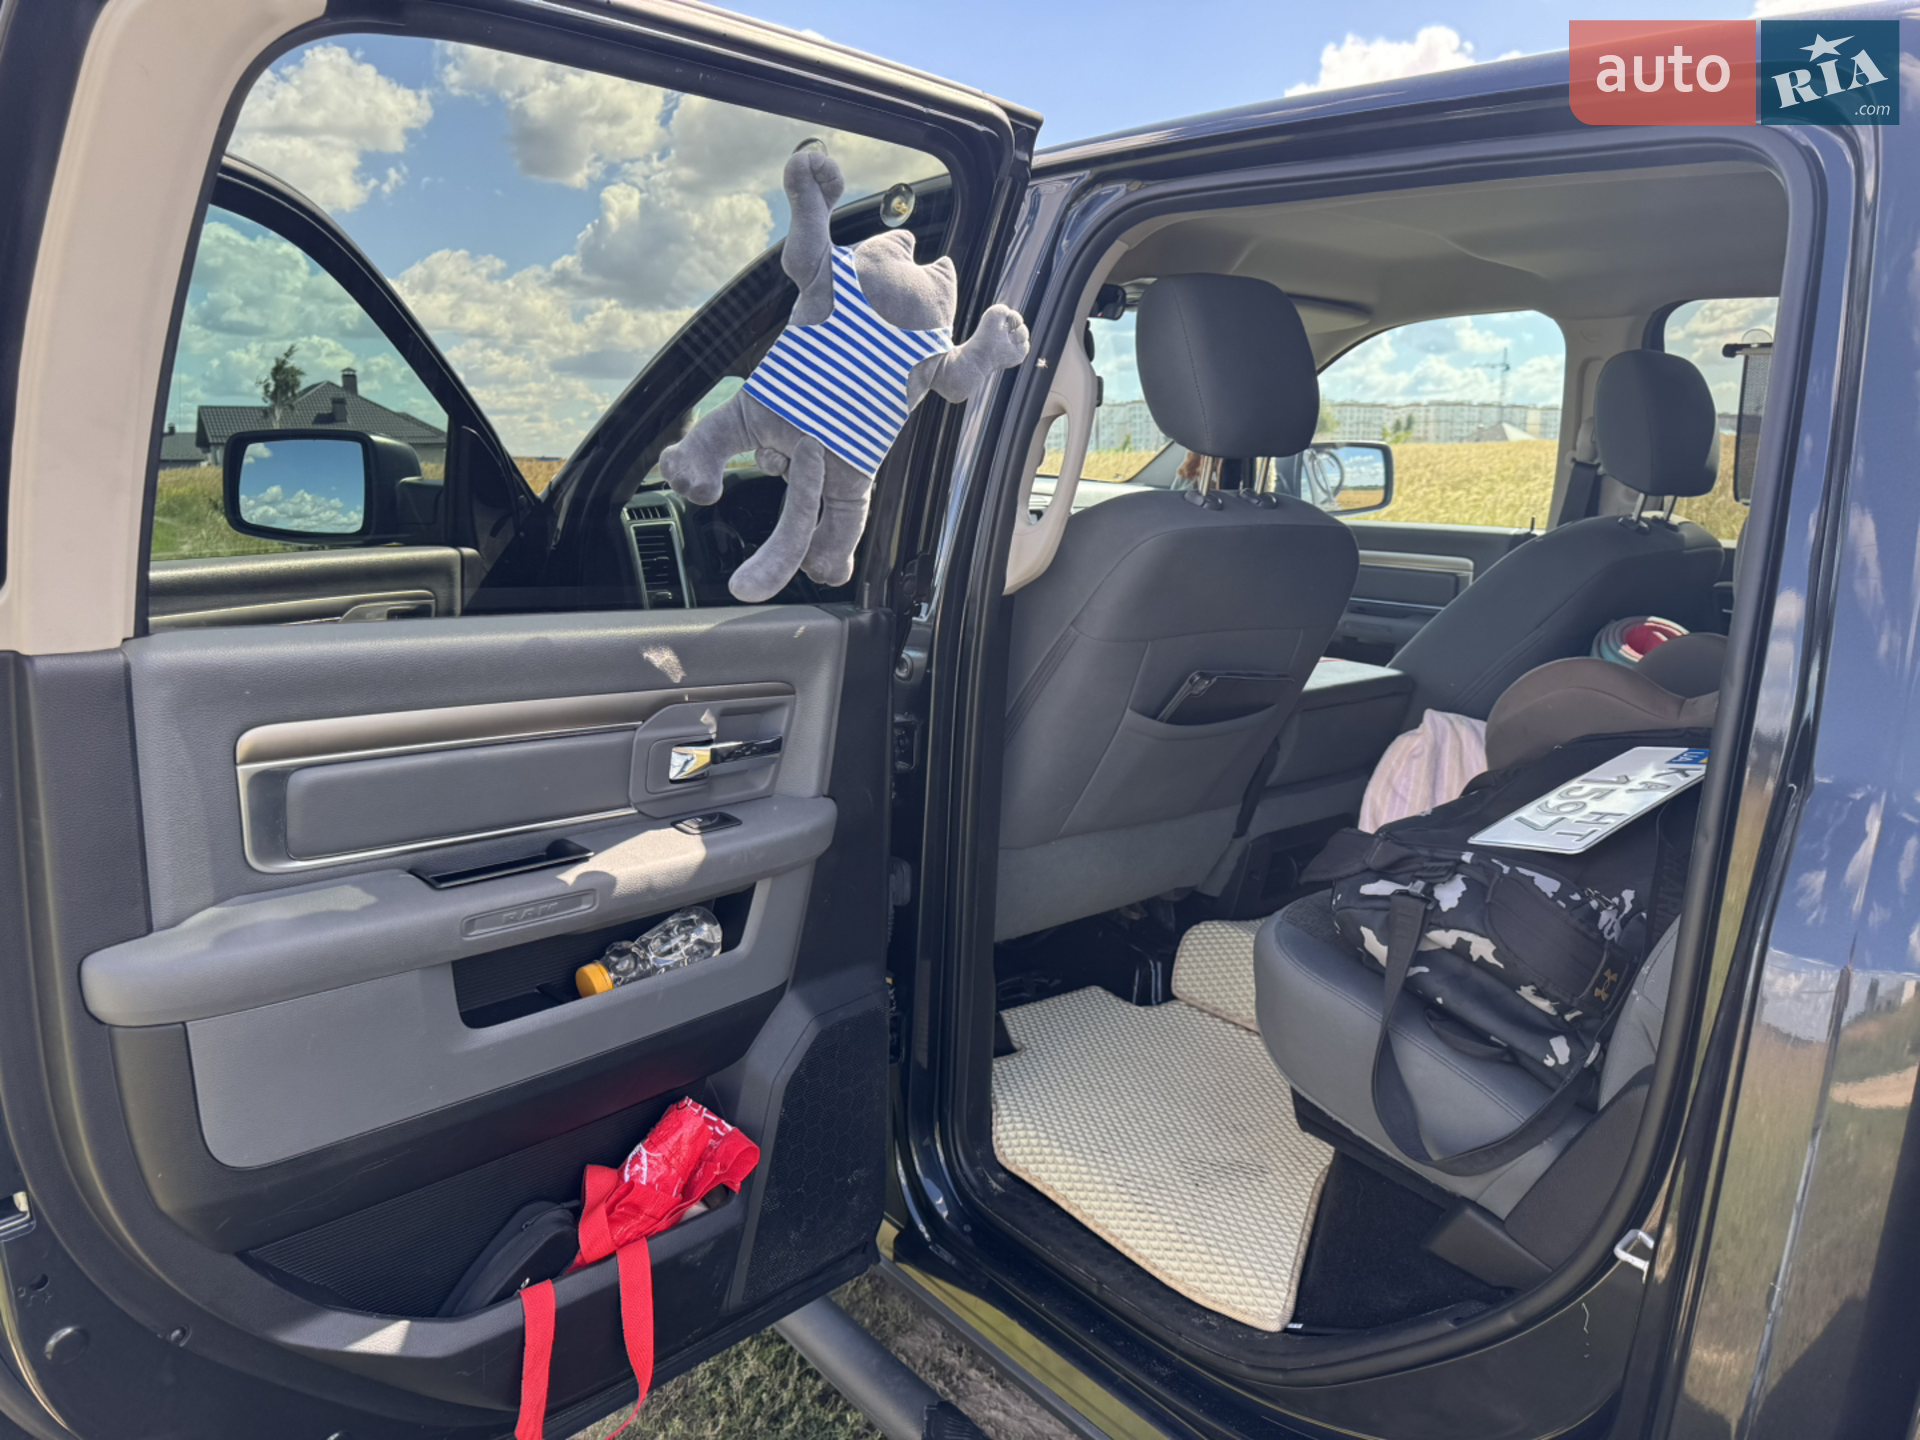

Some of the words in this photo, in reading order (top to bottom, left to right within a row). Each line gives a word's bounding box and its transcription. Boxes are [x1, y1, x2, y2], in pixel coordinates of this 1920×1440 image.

[1671, 751, 1705, 763] UA
[1625, 767, 1703, 793] KA
[1514, 774, 1631, 831] 1597
[1555, 811, 1629, 842] HT
[502, 902, 559, 924] RAM
